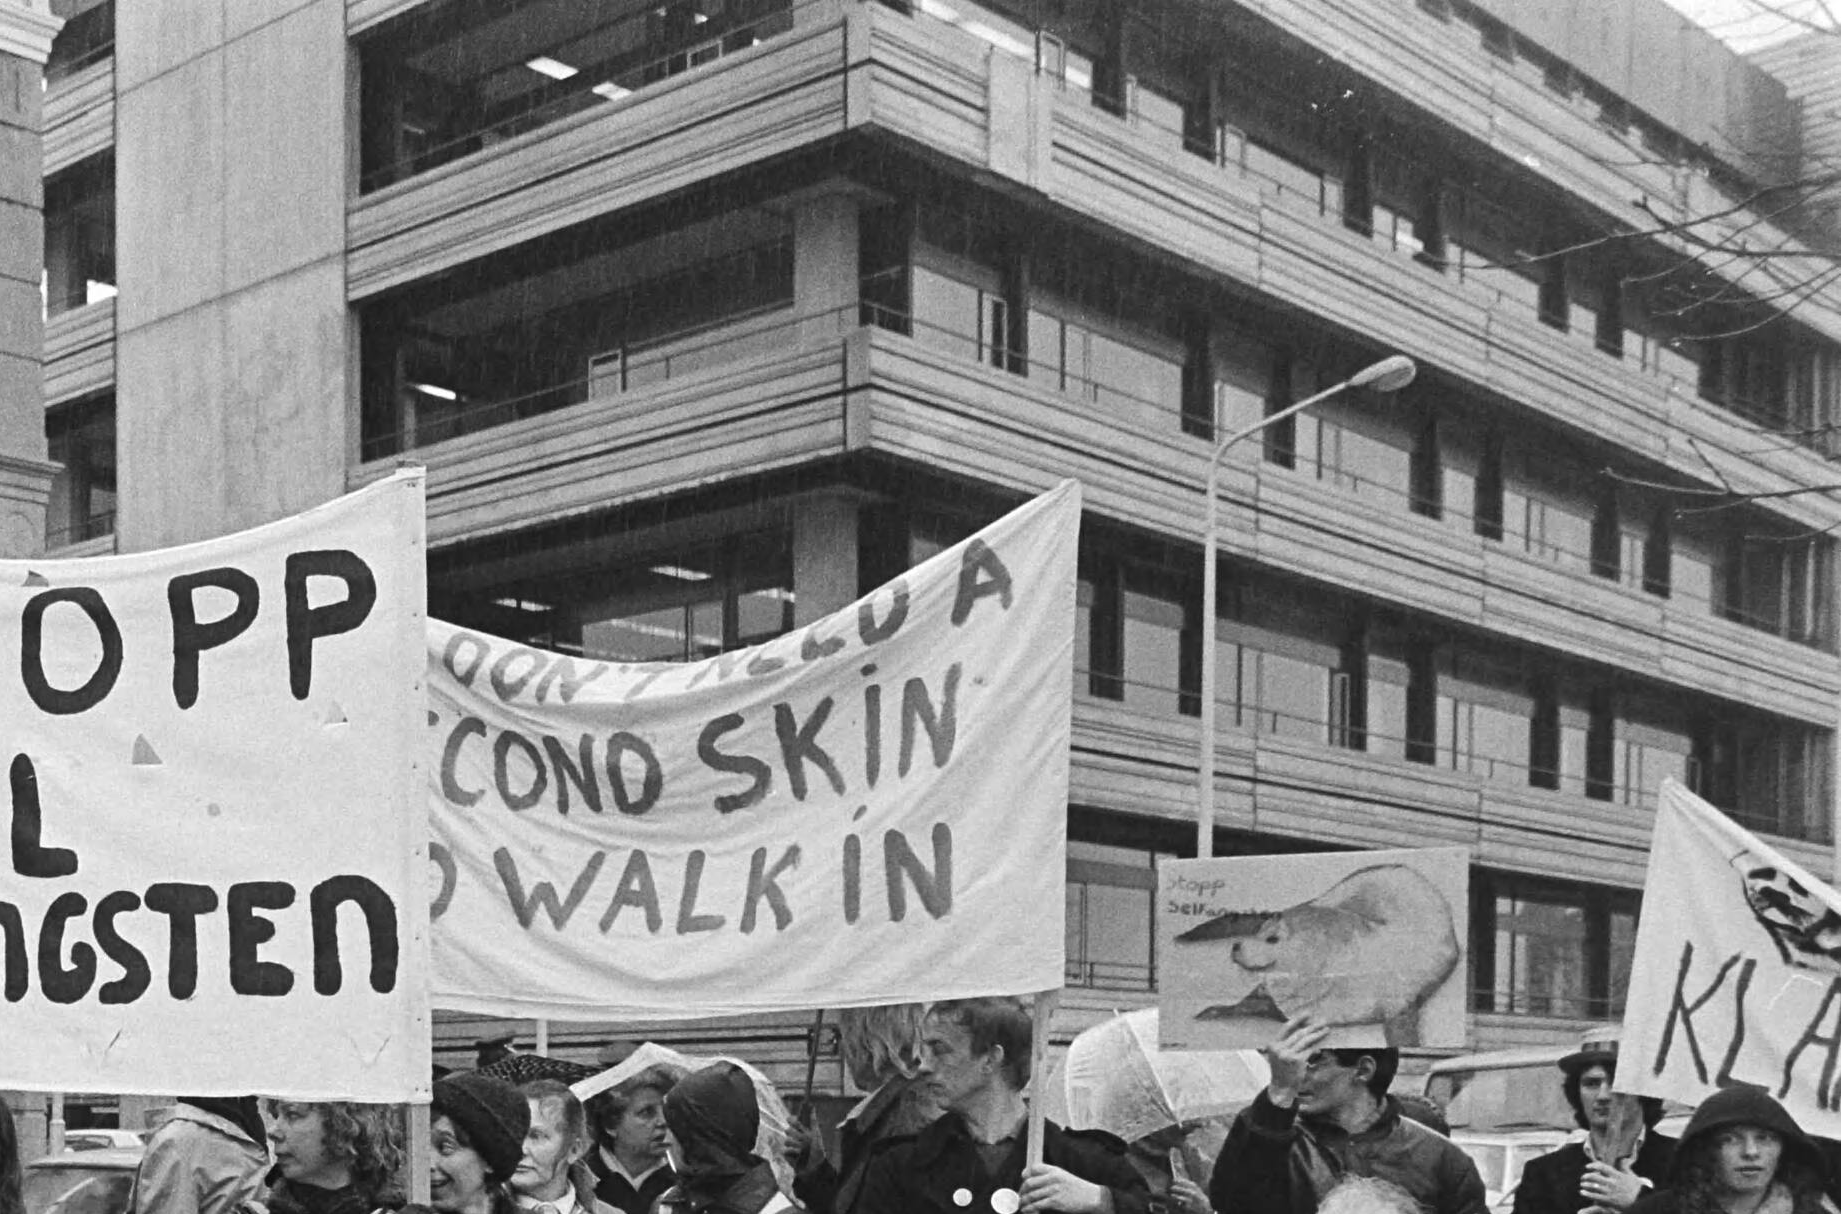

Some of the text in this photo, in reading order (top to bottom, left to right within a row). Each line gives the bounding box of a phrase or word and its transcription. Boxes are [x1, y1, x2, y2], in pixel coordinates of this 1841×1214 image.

[950, 538, 1013, 626] A
[428, 710, 662, 816] COND
[493, 844, 801, 936] WALK
[1653, 940, 1841, 1112] KLA
